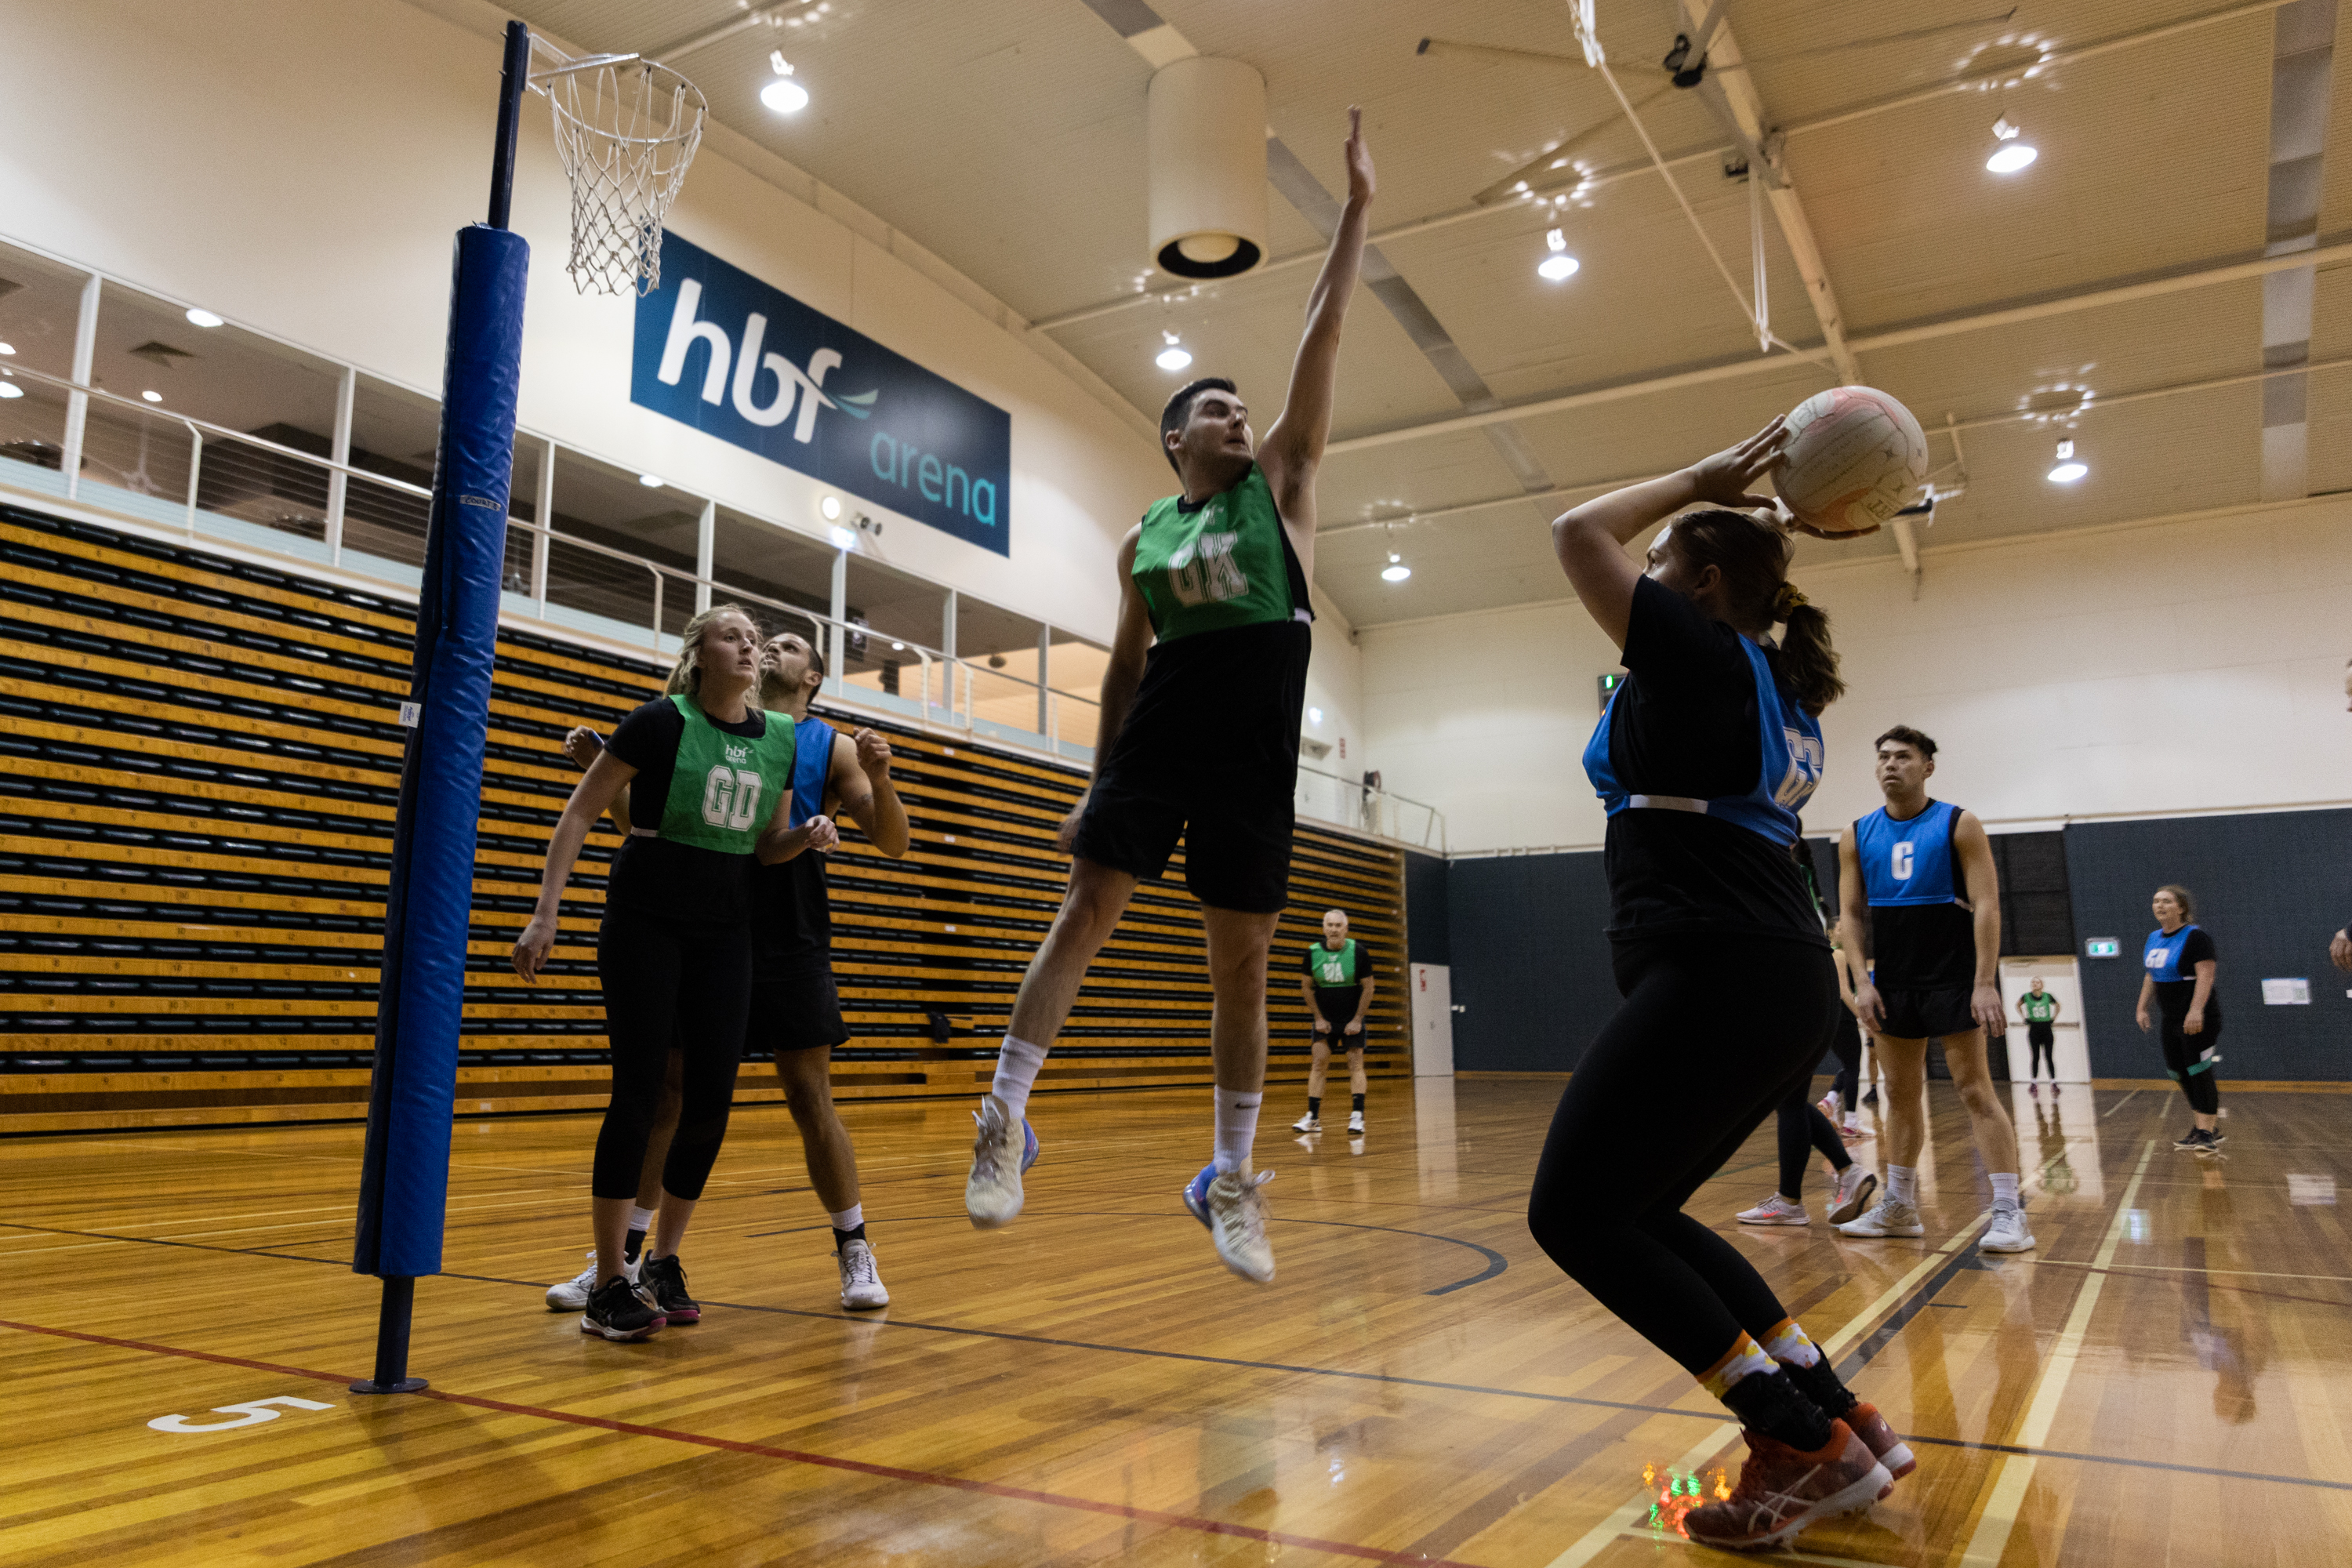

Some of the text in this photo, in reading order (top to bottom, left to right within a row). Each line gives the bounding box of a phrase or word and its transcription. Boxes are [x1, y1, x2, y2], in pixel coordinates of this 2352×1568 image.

[657, 277, 843, 444] hbf
[869, 430, 996, 528] arena
[1167, 530, 1250, 608] GK
[725, 744, 749, 758] hbf
[725, 755, 747, 764] arena
[702, 764, 763, 832] GD
[1891, 841, 1914, 880] C
[147, 1396, 336, 1433] 5
